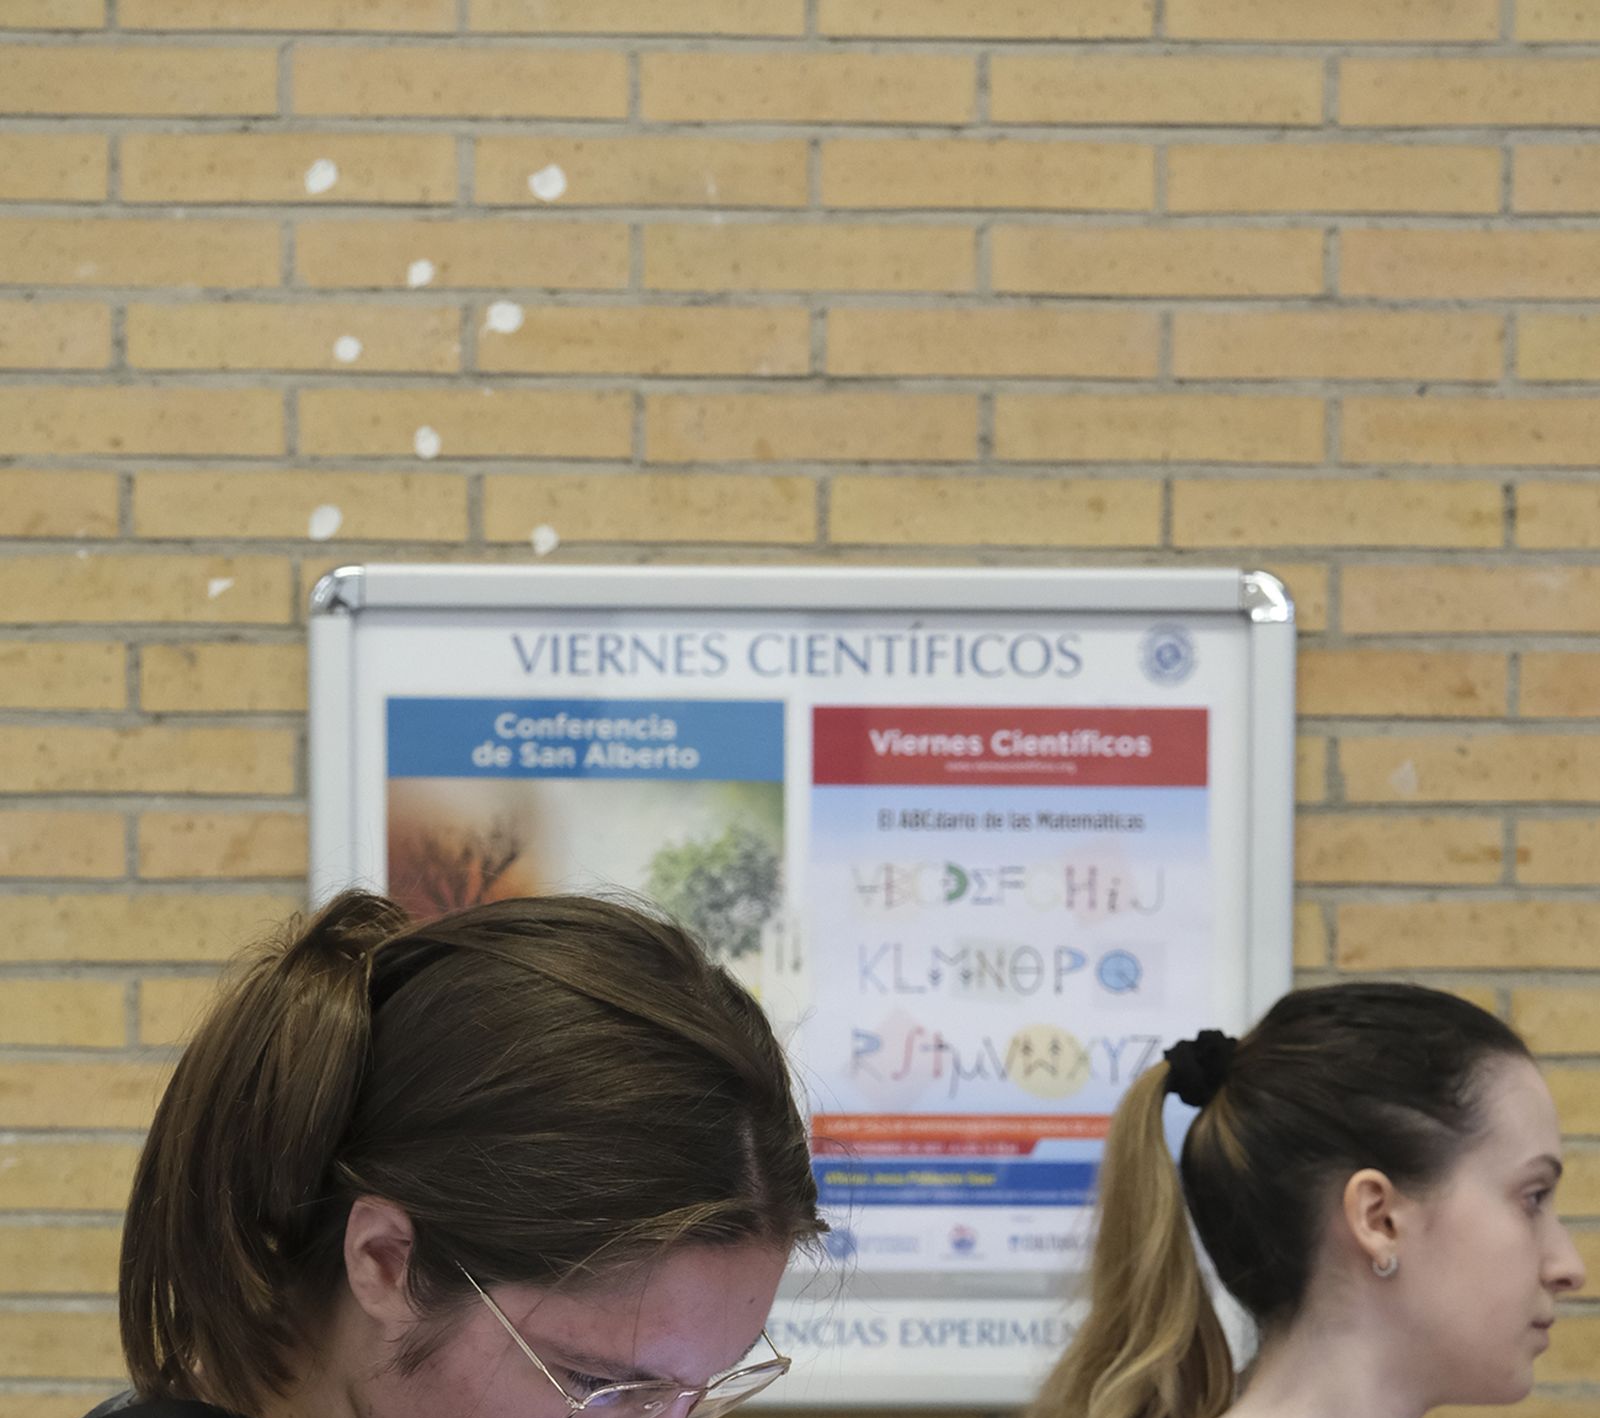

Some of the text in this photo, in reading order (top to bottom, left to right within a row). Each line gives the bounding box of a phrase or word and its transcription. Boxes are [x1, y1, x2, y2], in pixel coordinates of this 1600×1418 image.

[511, 632, 729, 678] VIERNES
[748, 621, 1084, 679] CIENTÍFICOS
[494, 712, 678, 741] Conferencia
[471, 740, 700, 770] de San Alberto
[869, 728, 1152, 758] Viernes Científicos
